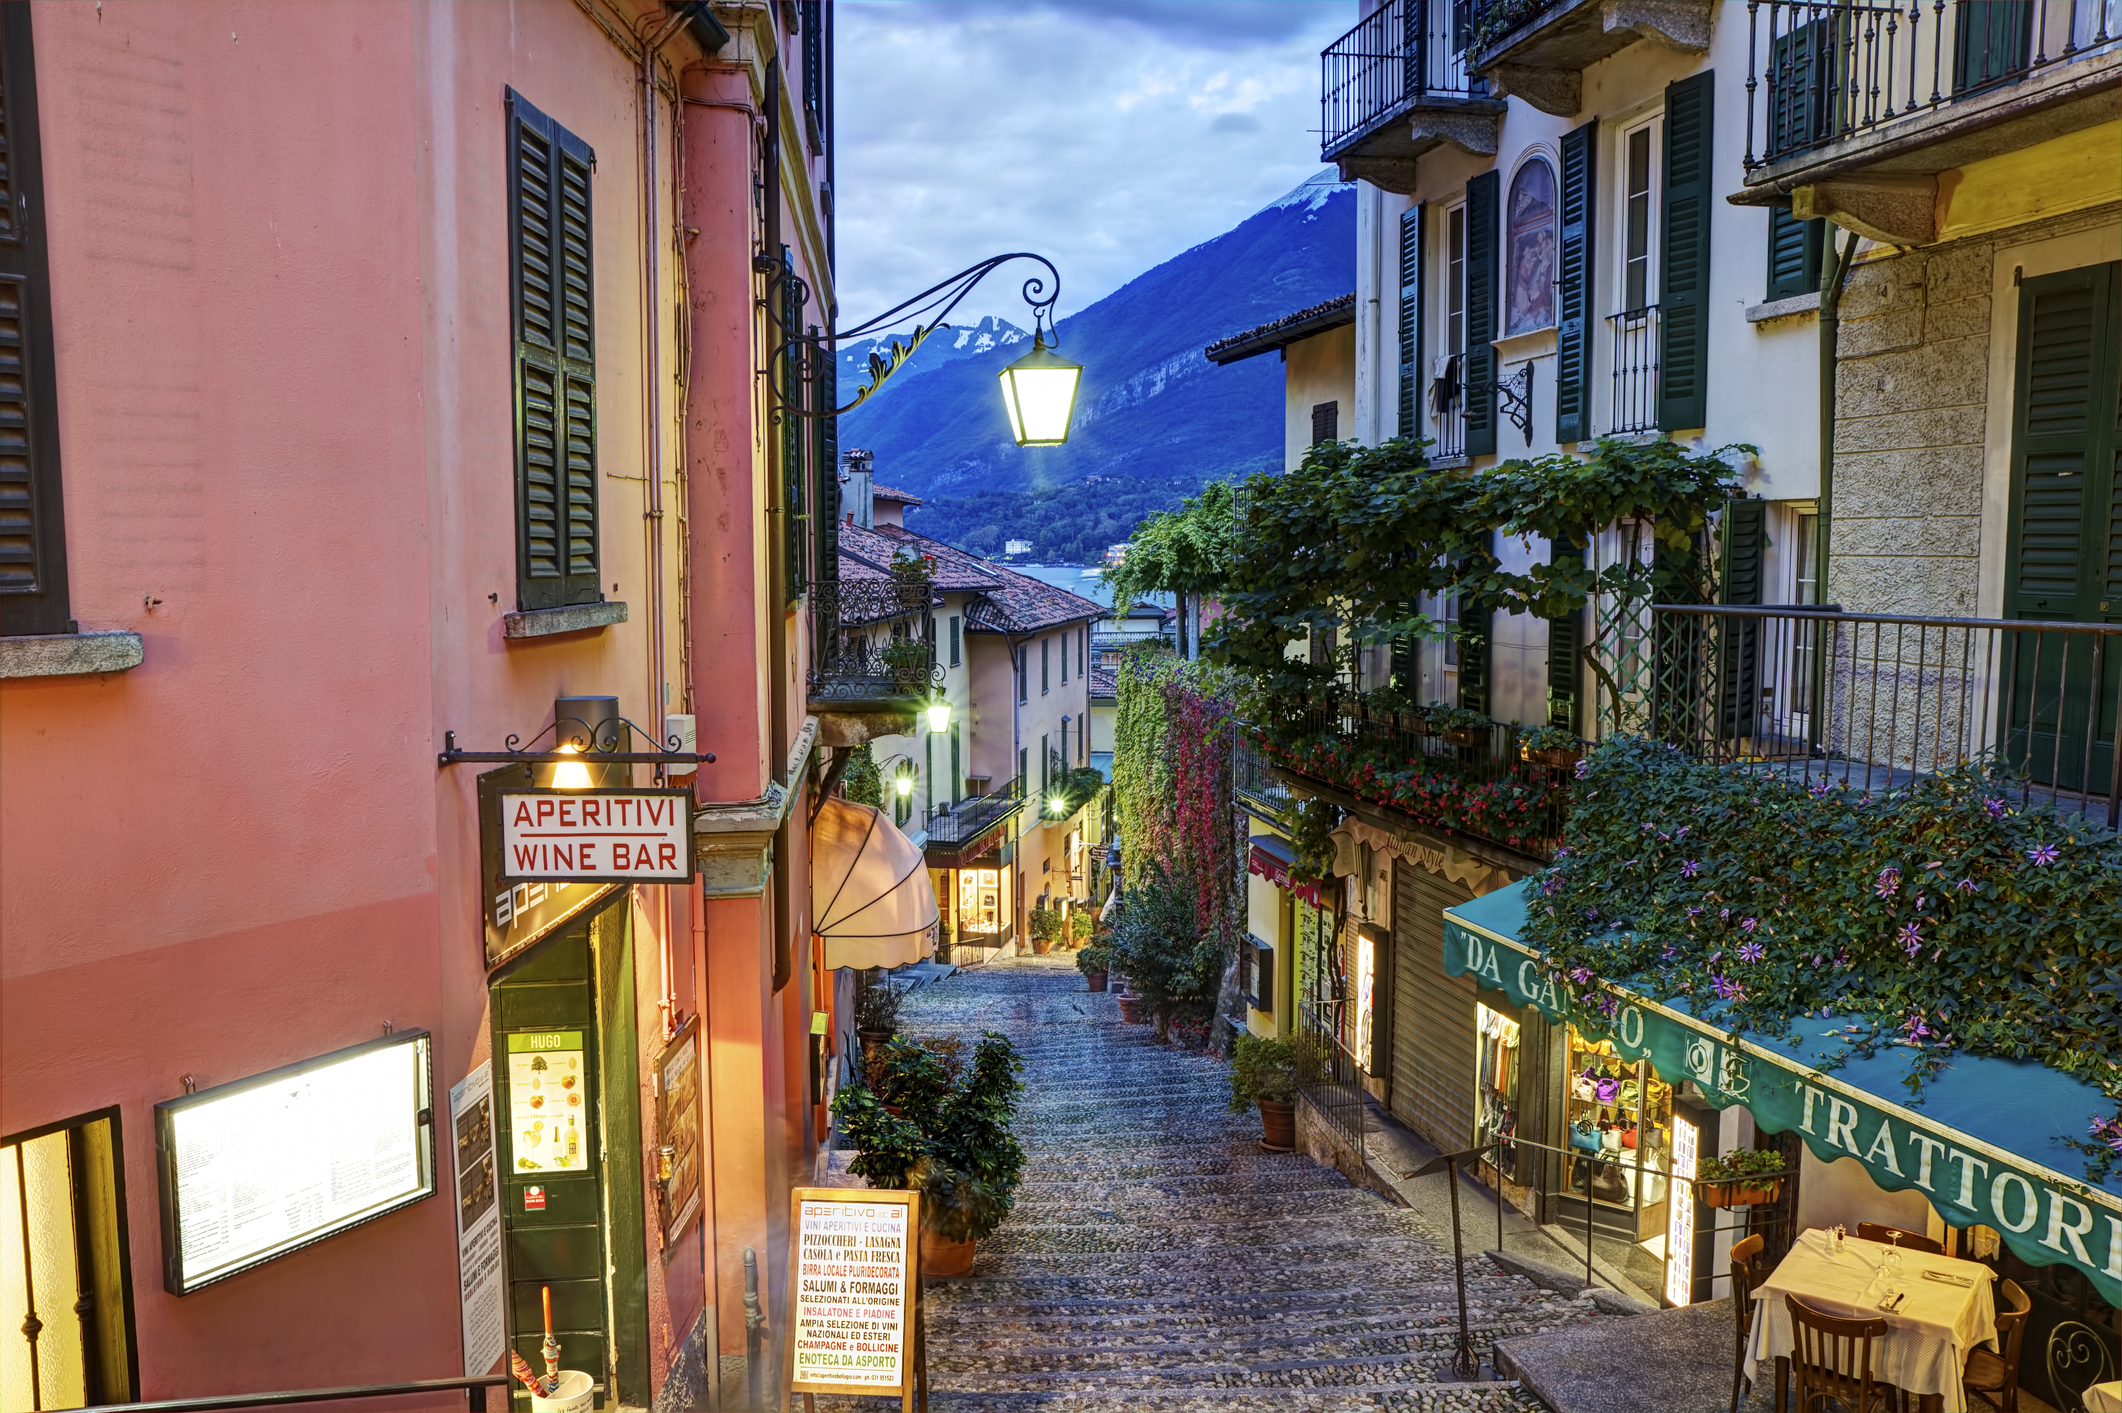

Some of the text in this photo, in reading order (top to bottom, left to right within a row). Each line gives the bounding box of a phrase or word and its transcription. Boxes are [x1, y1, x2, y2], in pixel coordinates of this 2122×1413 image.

[513, 799, 674, 827] APERITIVI
[513, 843, 678, 871] WINE BAR
[1387, 833, 1445, 870] Italian Style
[530, 1035, 561, 1049] HUGO
[805, 1206, 875, 1218] aperitivo
[891, 1207, 902, 1218] al
[805, 1220, 901, 1233] VINI APERITIVI E CUCINA
[804, 1234, 856, 1247] PIZZOCCHERI
[865, 1236, 901, 1248] LASAGNA
[804, 1247, 900, 1263] CASÖLA e PASTA FRESCA
[803, 1264, 899, 1279] BIRRA LOCALE PLURIDECORATA
[803, 1280, 898, 1295] SALUMI & FORMAGGI
[800, 1295, 900, 1306] SELEZIONATI ALL'ORIGINE
[804, 1307, 895, 1319] INSALATONE E PIADINE
[800, 1319, 898, 1330] AMPIA SELEZIONE DI VINI
[807, 1330, 848, 1339] NAZIONALI
[863, 1332, 890, 1341] ESTERI
[798, 1340, 899, 1353] CHAMPAGNE e BOLLICINE
[800, 1353, 896, 1368] ENOTECA DA ASPORTO
